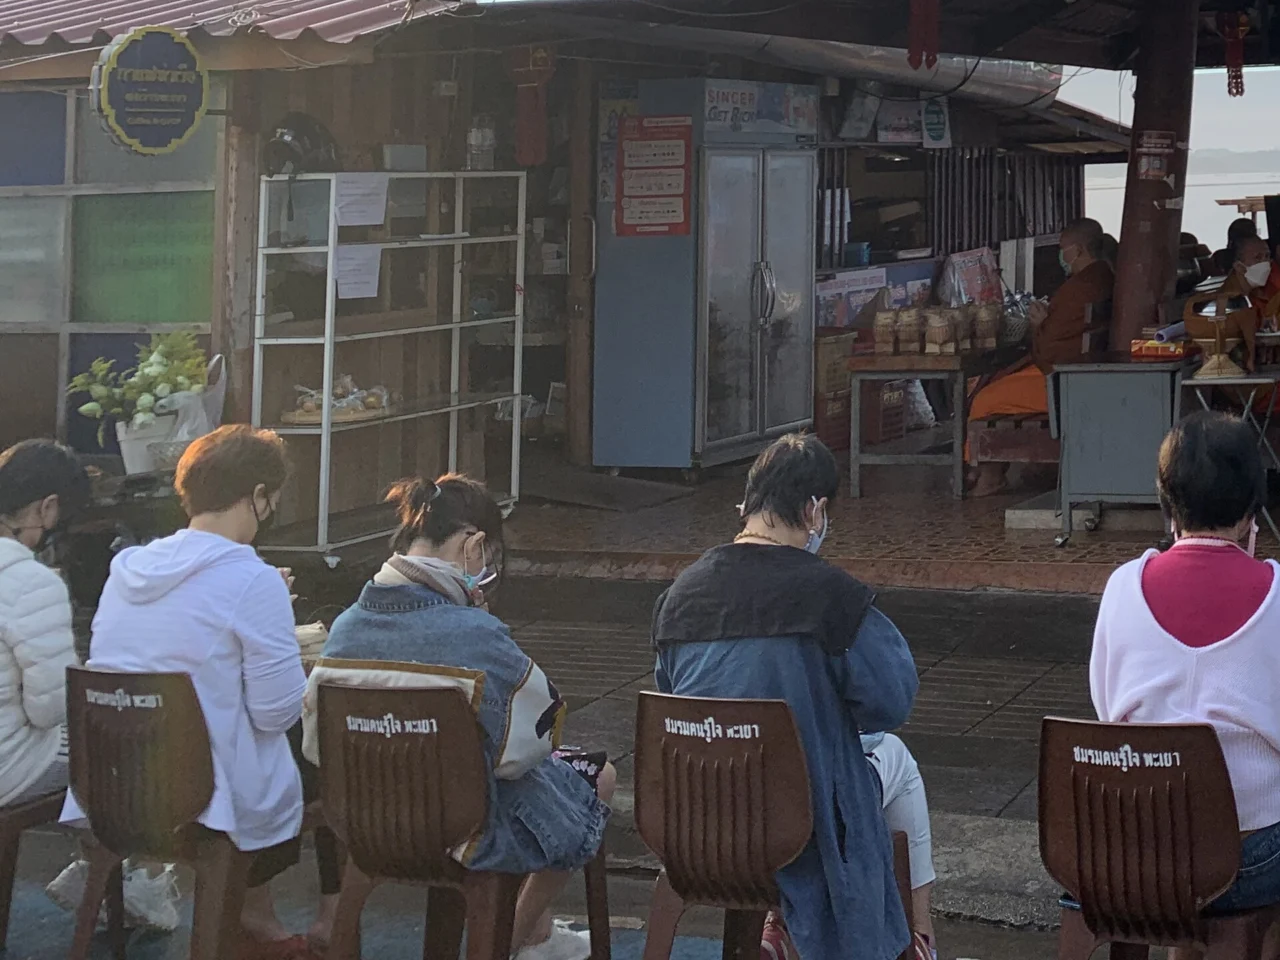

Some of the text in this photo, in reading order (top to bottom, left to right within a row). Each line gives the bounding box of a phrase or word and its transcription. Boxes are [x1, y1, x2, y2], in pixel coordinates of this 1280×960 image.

[707, 89, 756, 106] SINGER
[664, 716, 759, 743] ชมรมคนรู้ใจ พะเยา
[1073, 744, 1180, 772] ชมรมคนรู้ใจ พะเยา
